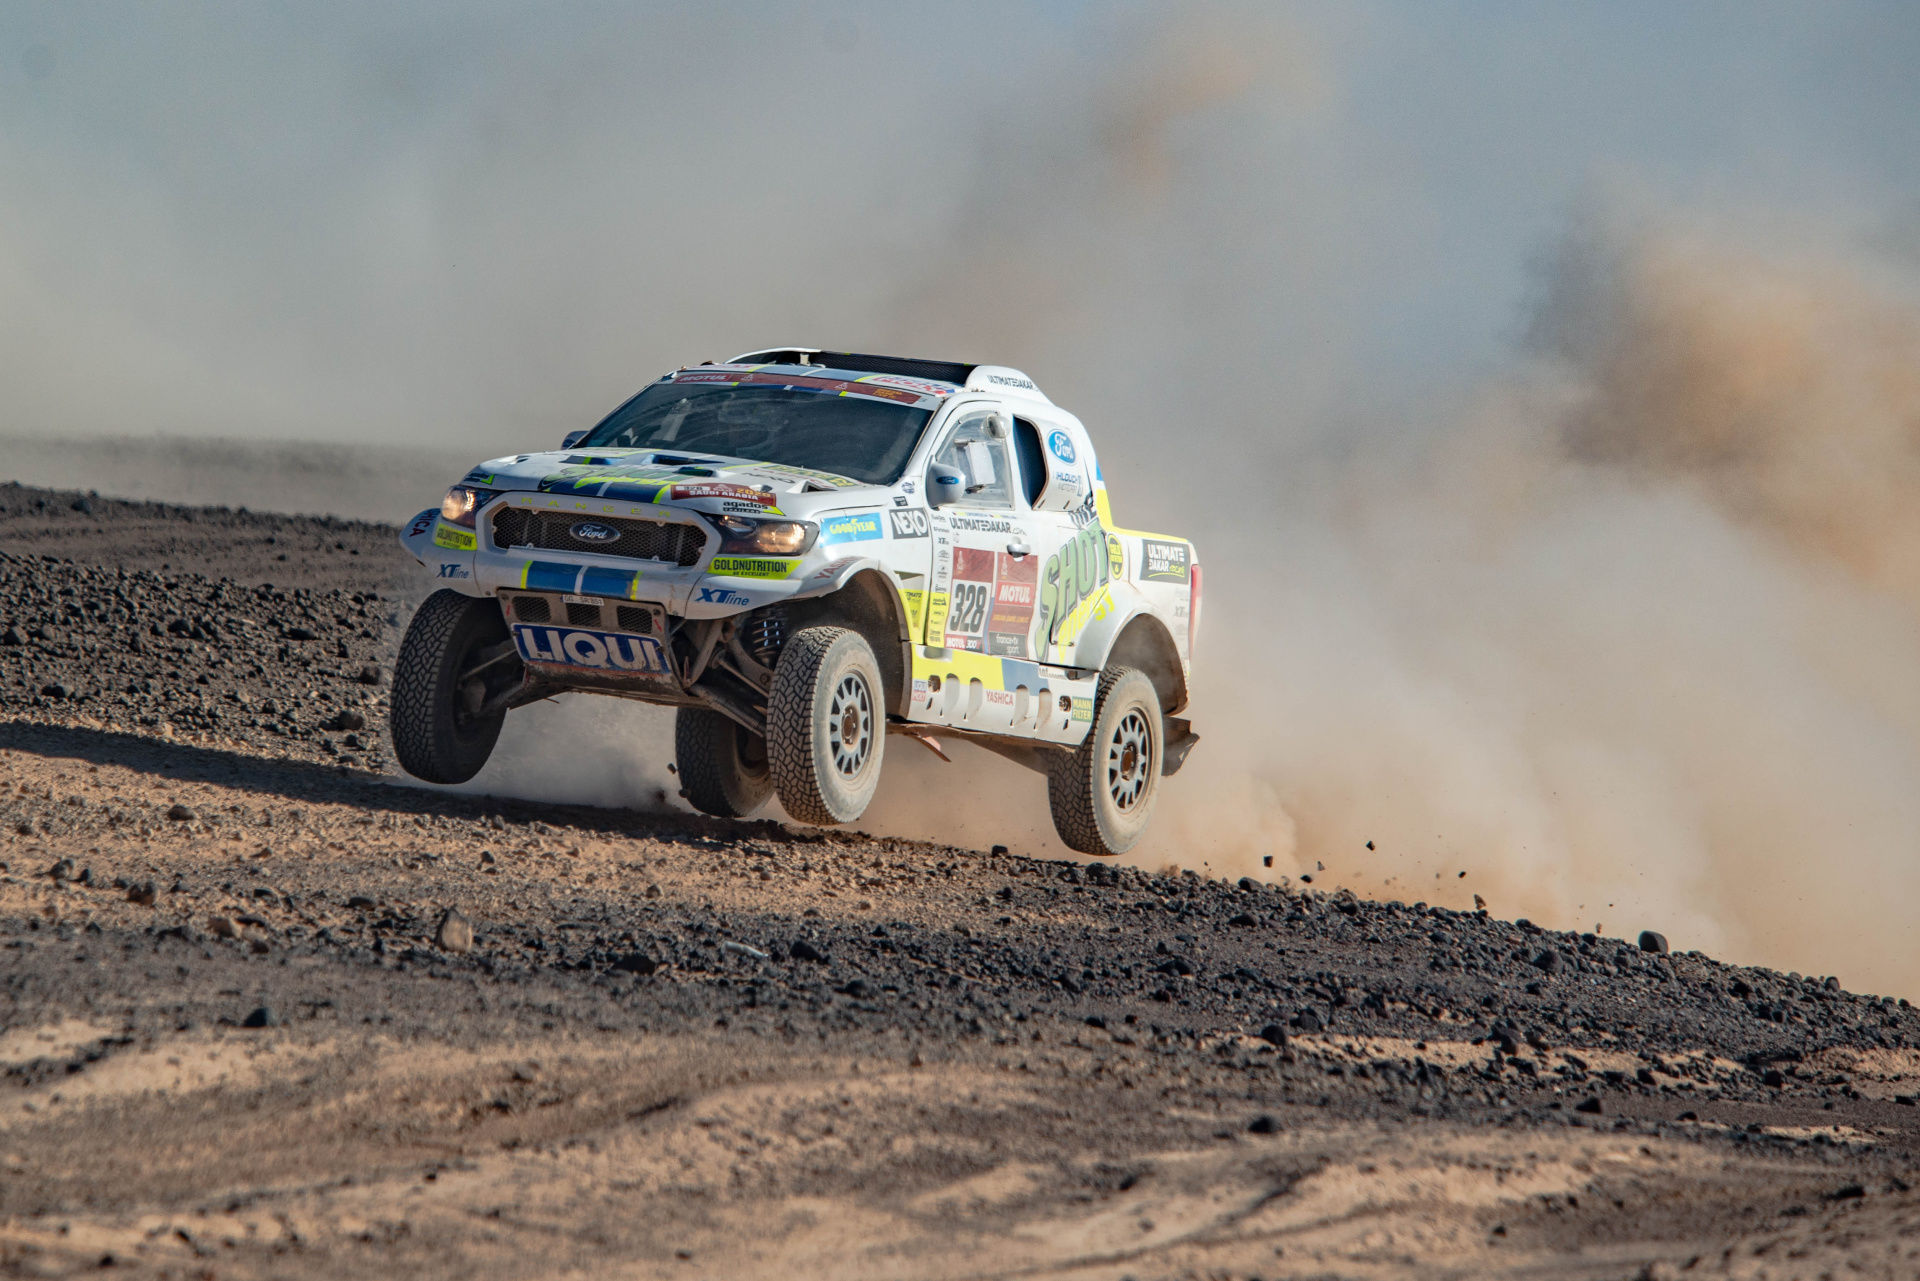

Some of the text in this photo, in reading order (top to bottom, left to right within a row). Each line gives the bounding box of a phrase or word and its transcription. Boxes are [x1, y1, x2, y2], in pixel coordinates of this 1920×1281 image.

[1055, 433, 1075, 461] Ford
[722, 491, 758, 501] ARABIA
[521, 497, 671, 518] RANGER
[723, 501, 768, 510] agados
[579, 524, 609, 540] Ford
[890, 510, 928, 537] NEXO
[1148, 544, 1185, 562] ULTIMATE
[436, 563, 470, 579] XTline
[713, 559, 788, 573] GOLDNUTRITION
[695, 587, 750, 606] XTline
[999, 584, 1030, 604] MOTUL
[1035, 517, 1109, 663] SHOT
[949, 583, 987, 633] 328
[520, 628, 662, 671] LIQUI
[946, 637, 966, 649] MOTUL
[985, 690, 1014, 707] YASHICA
[1073, 709, 1092, 721] FILTER
